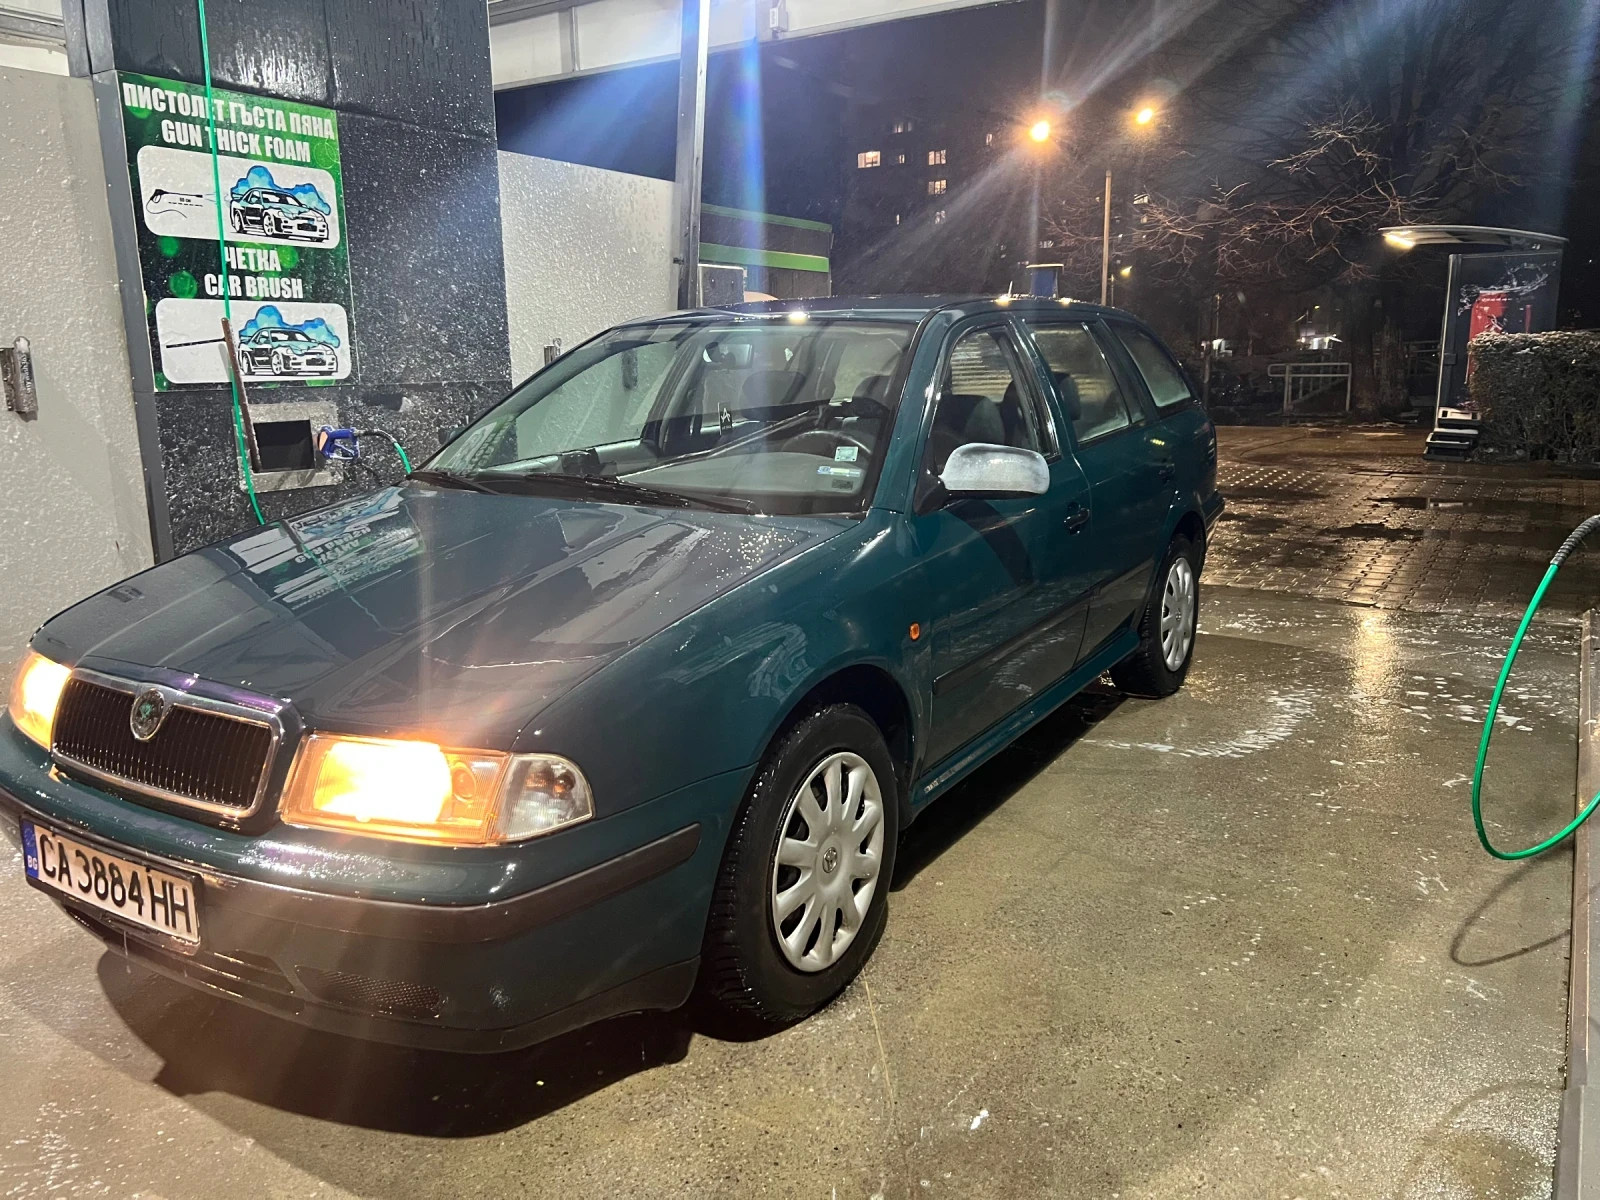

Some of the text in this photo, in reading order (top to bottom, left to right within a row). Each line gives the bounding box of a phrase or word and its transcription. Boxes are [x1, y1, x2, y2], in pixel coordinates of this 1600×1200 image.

[122, 82, 335, 140] ПИСТОЛЕТ ГЪСТА ПЯНА
[161, 119, 311, 163] GUN THICK FOAM
[223, 246, 282, 272] ЧЕТКА
[204, 273, 304, 299] CAR BRUSH
[27, 855, 38, 869] BG
